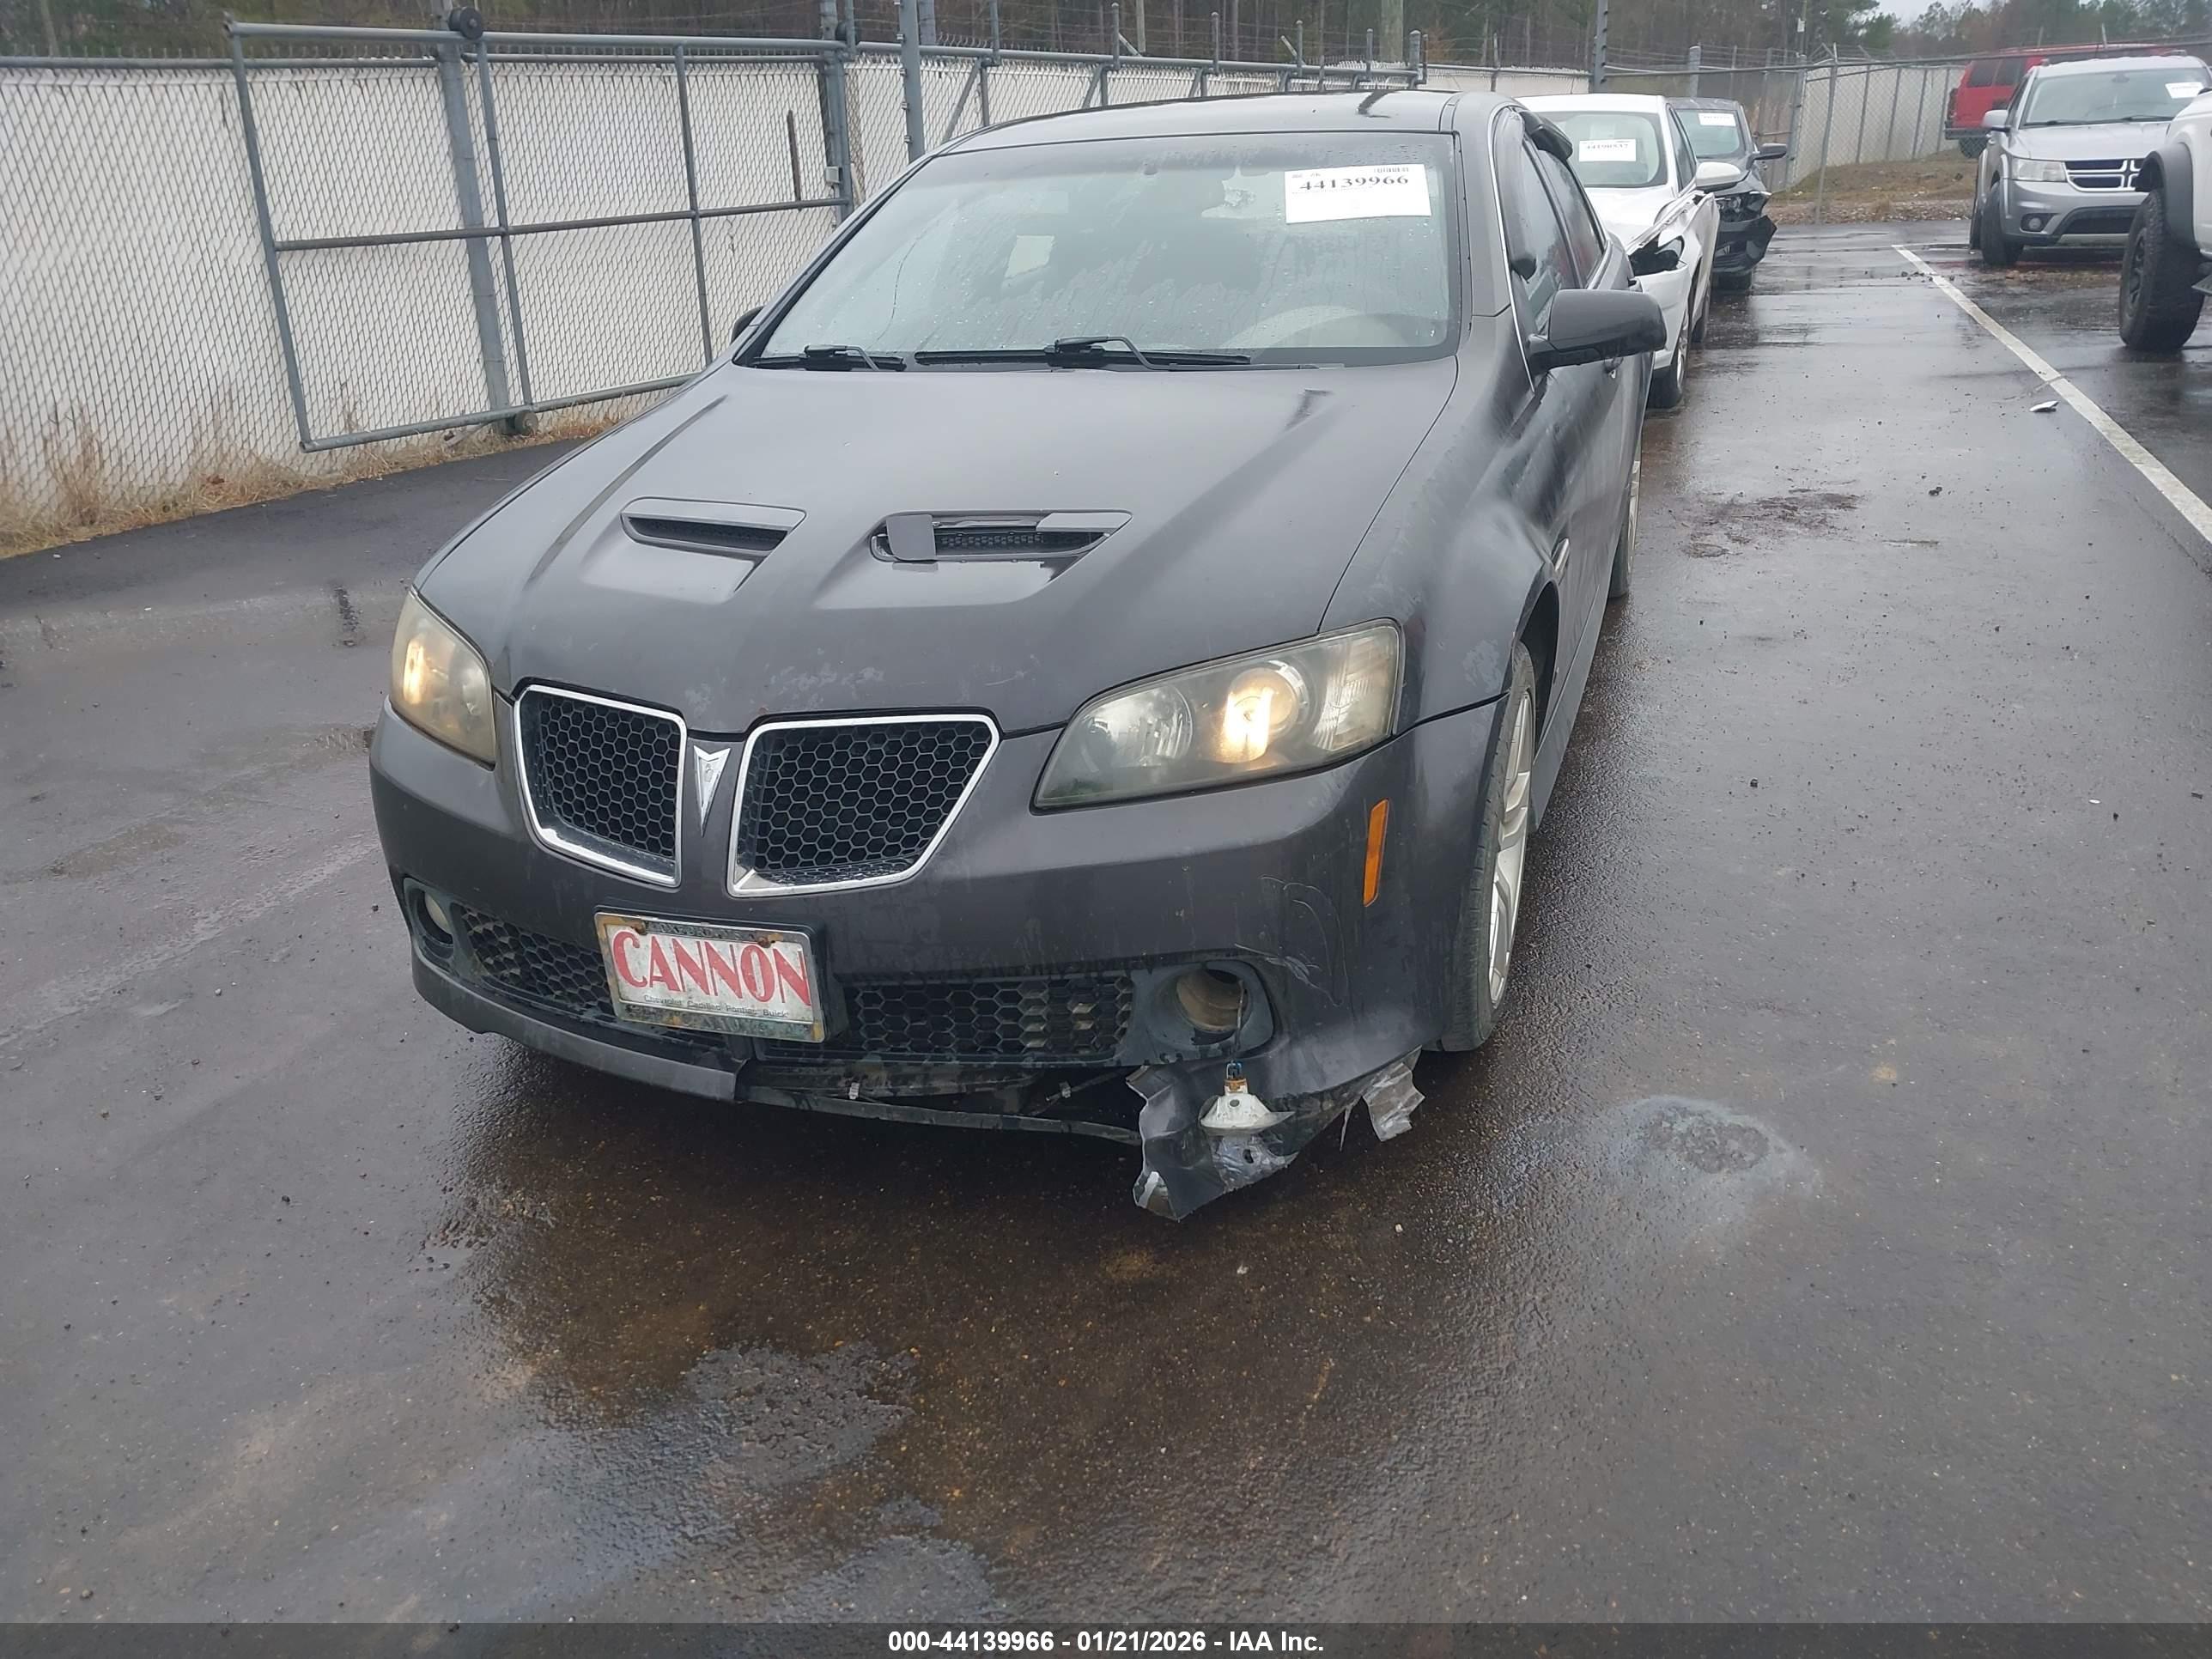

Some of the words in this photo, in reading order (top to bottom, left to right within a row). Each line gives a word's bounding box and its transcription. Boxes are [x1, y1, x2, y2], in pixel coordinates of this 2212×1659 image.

[1300, 175, 1409, 191] 44139966
[612, 929, 811, 1006] CANNON
[644, 994, 683, 1006] Chevrolet
[687, 1000, 721, 1012] Cadillac
[726, 1003, 757, 1015] Pontiac
[763, 1009, 788, 1019] Buick
